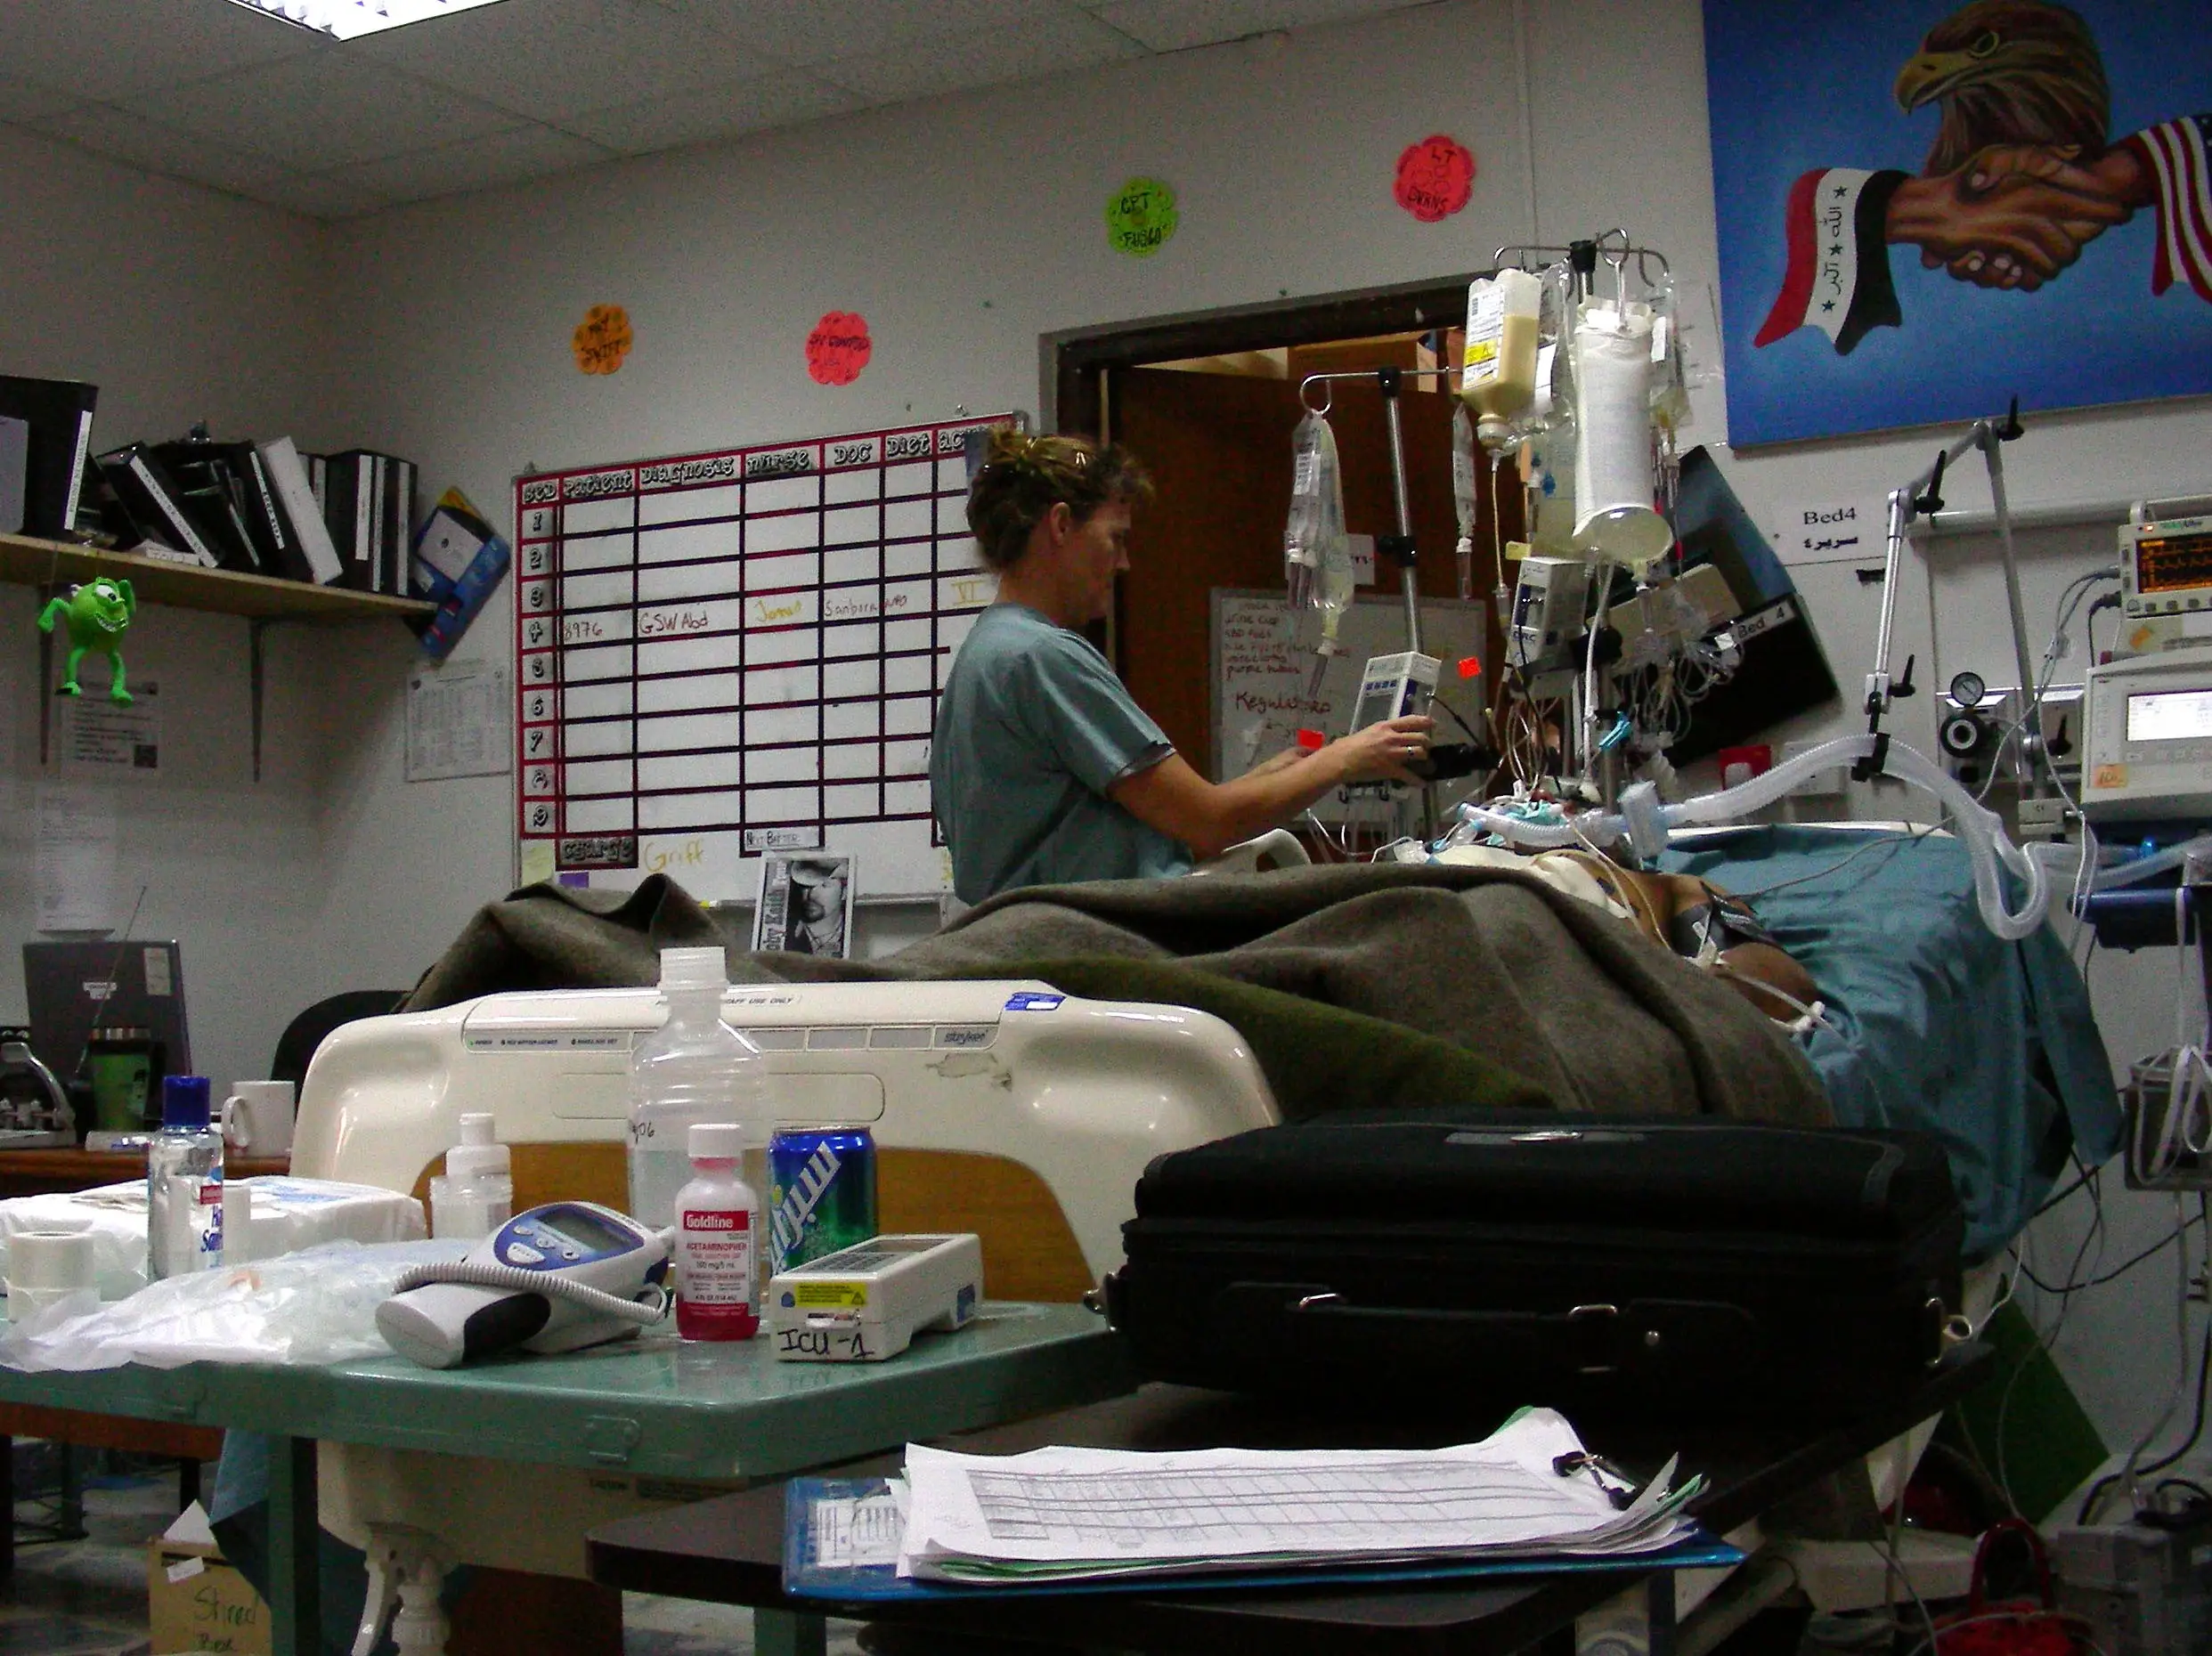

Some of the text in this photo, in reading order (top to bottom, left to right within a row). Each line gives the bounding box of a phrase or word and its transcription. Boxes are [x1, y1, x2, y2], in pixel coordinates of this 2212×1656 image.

[1803, 507, 1858, 525] Bed4
[530, 548, 543, 570] 2
[528, 621, 544, 644] 4
[639, 614, 679, 635] GSW
[687, 1214, 735, 1229] Goldline
[777, 1328, 831, 1356] ICU
